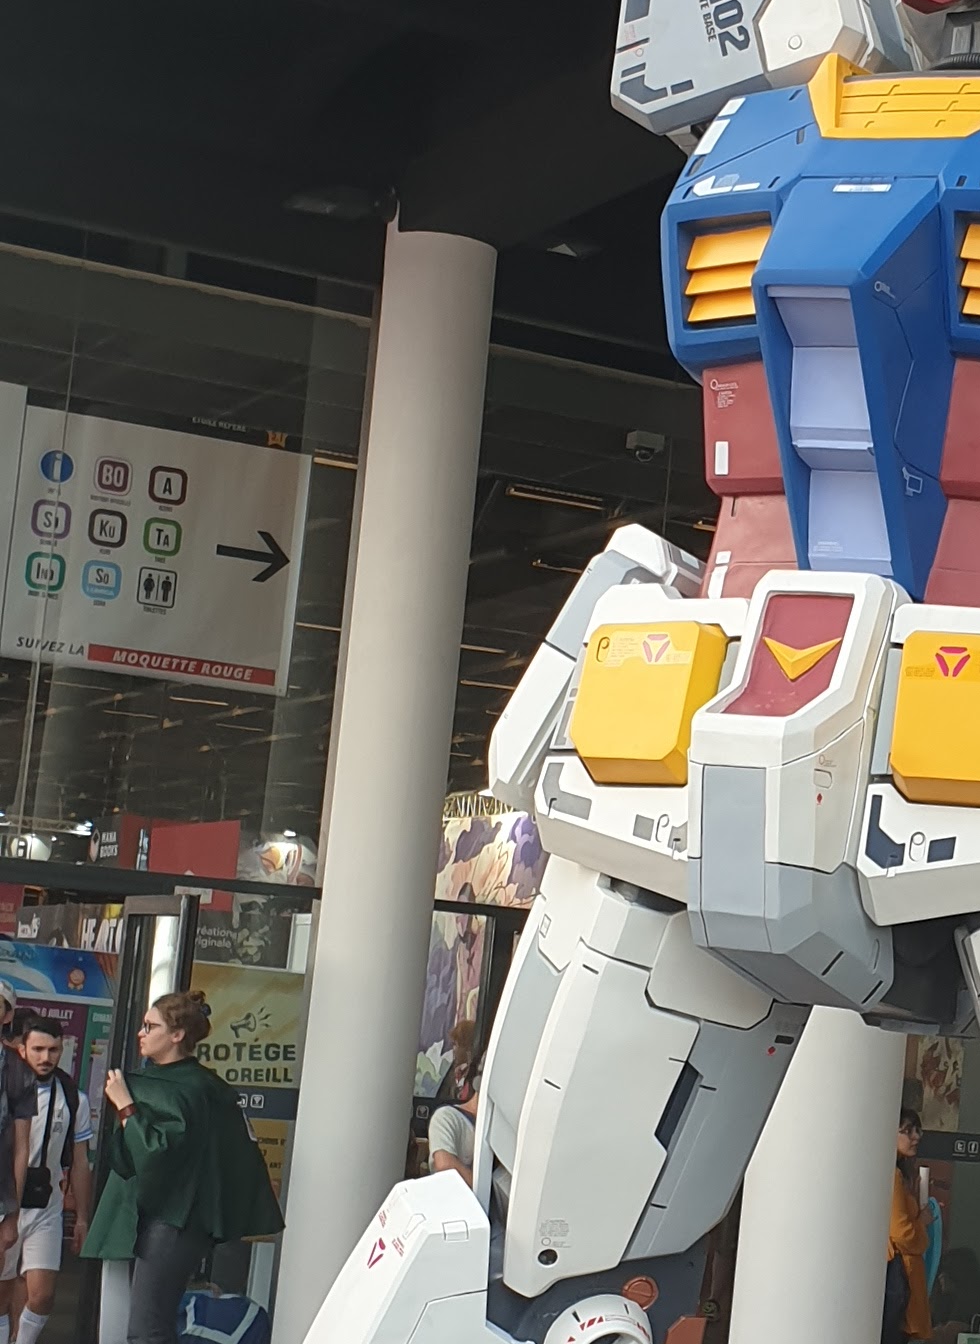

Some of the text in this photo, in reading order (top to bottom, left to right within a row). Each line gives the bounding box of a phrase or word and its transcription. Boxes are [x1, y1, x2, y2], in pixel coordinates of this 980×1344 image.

[703, 13, 717, 42] BASE
[102, 464, 123, 487] BO
[162, 477, 172, 495] A
[16, 636, 85, 656] SUIVEZ LA
[112, 650, 254, 681] MOQUETTE ROUGE
